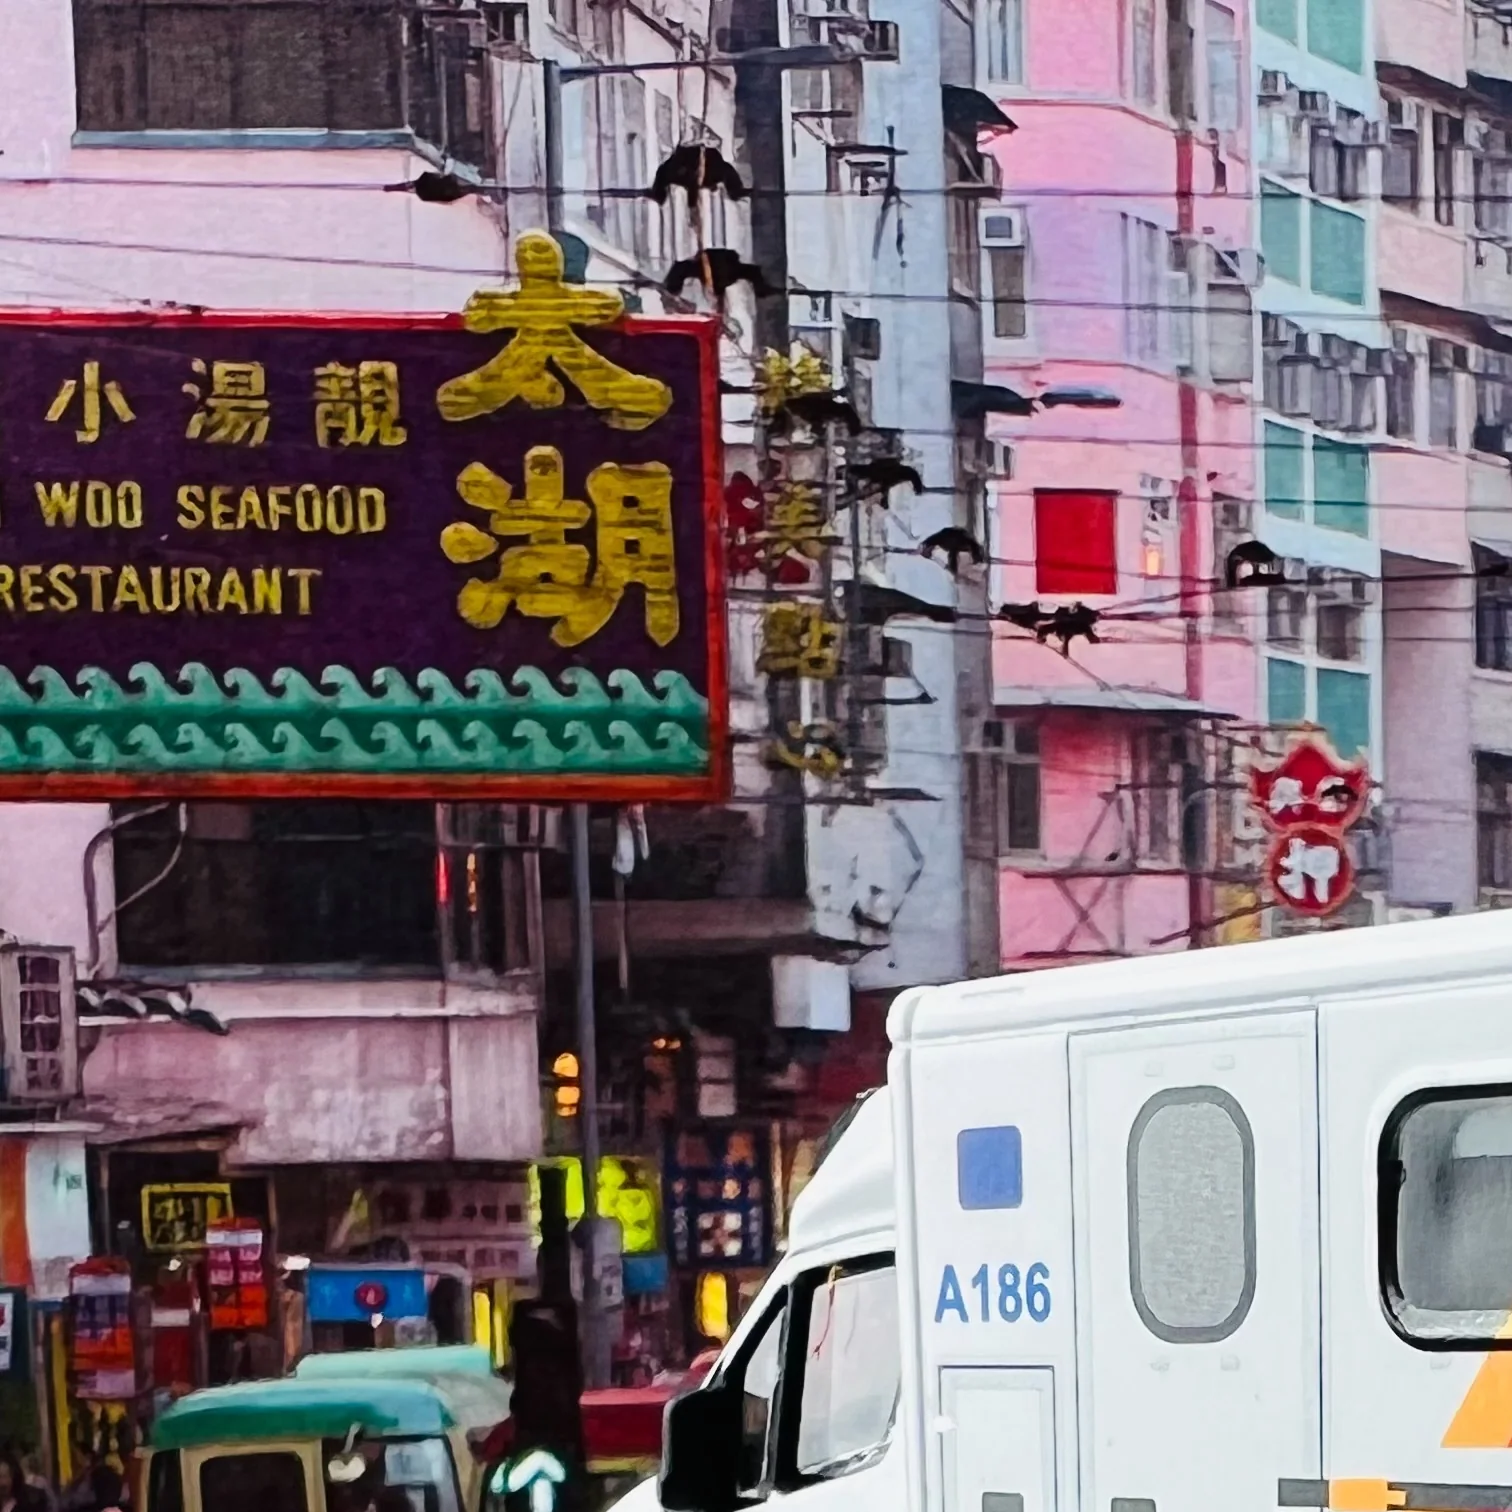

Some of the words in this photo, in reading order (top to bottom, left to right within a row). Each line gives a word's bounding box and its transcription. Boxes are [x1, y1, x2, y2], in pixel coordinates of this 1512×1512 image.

[34, 480, 142, 529] WOO
[176, 484, 387, 535] SEAFOOD
[0, 564, 323, 616] RESTAURANT
[933, 1261, 1051, 1324] A186
